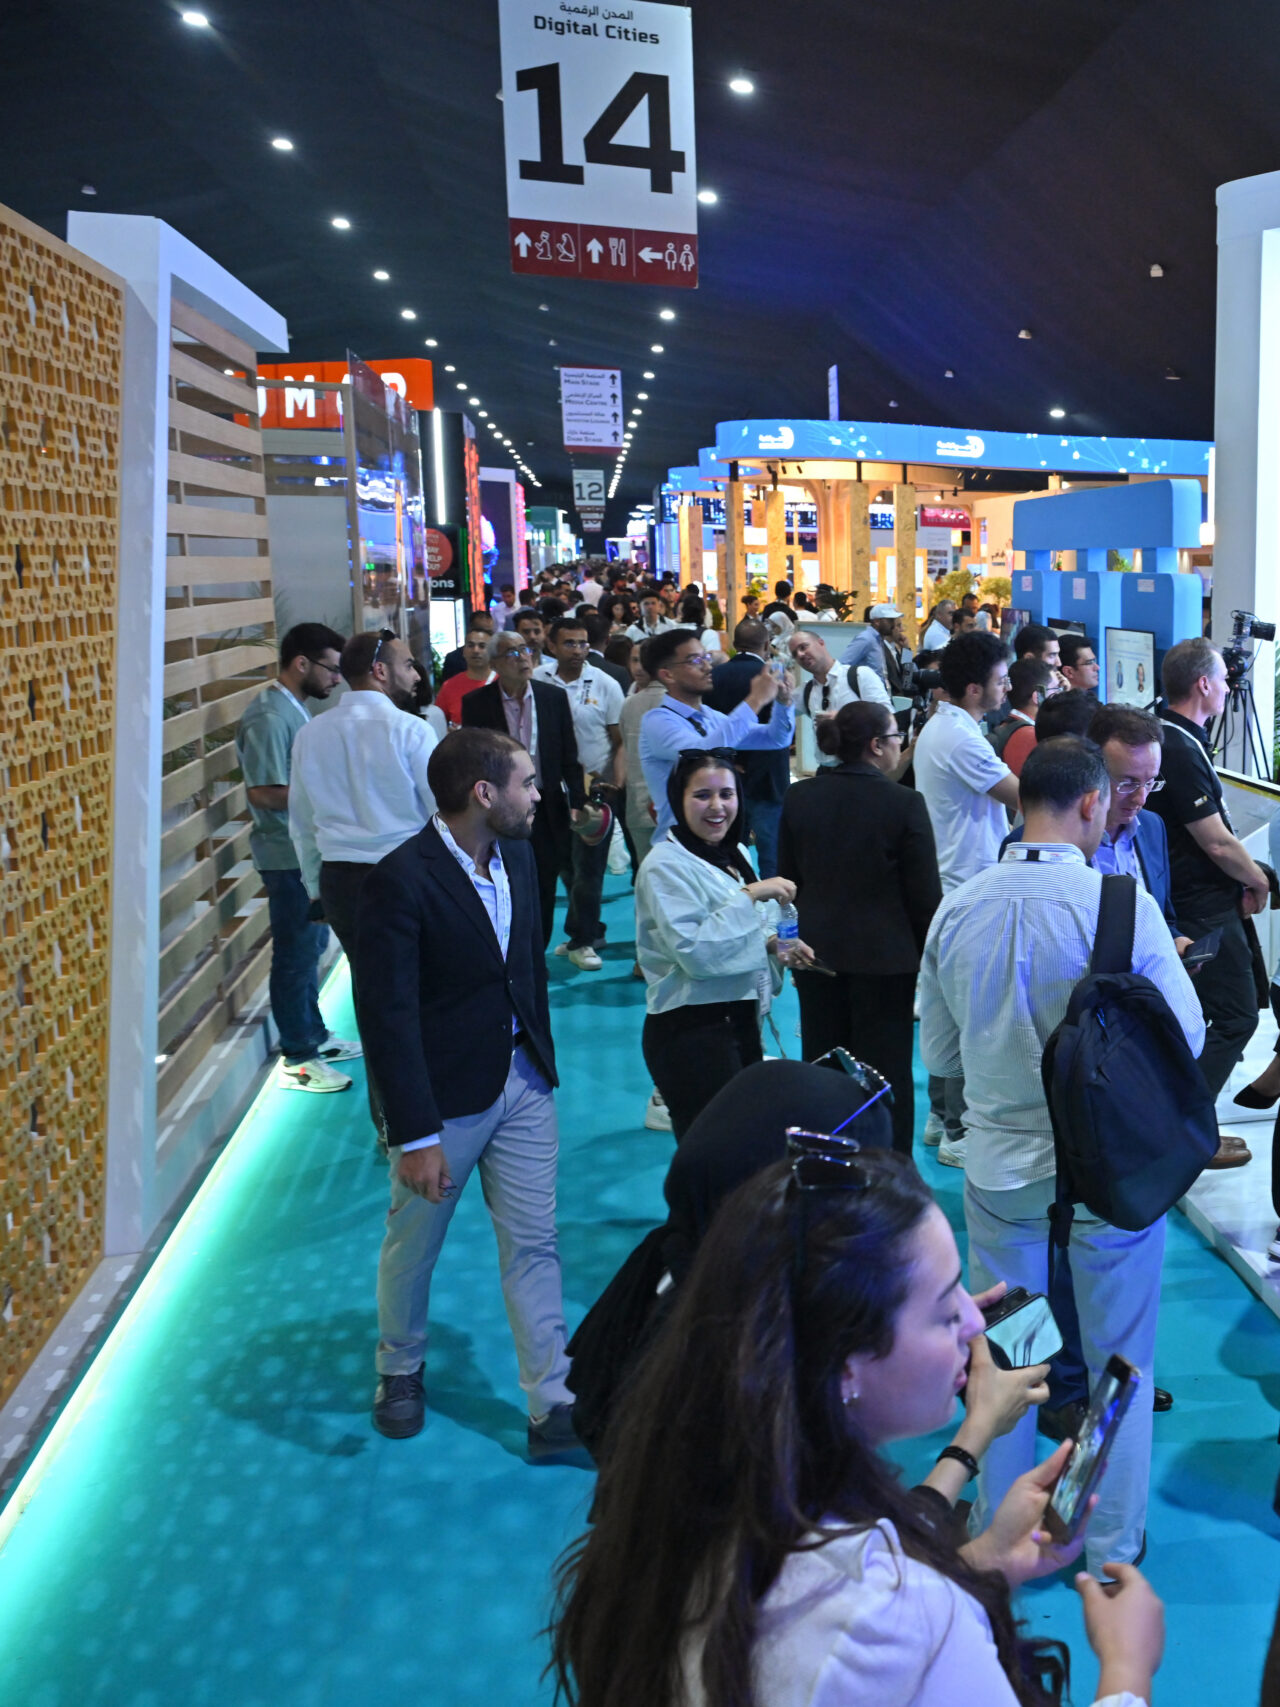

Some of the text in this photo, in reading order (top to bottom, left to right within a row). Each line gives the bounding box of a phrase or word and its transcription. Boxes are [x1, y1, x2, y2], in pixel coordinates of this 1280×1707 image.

[559, 2, 634, 21] المدن الرقمية
[533, 15, 660, 45] Digital Cities
[516, 62, 686, 195] 14
[575, 482, 603, 501] 12
